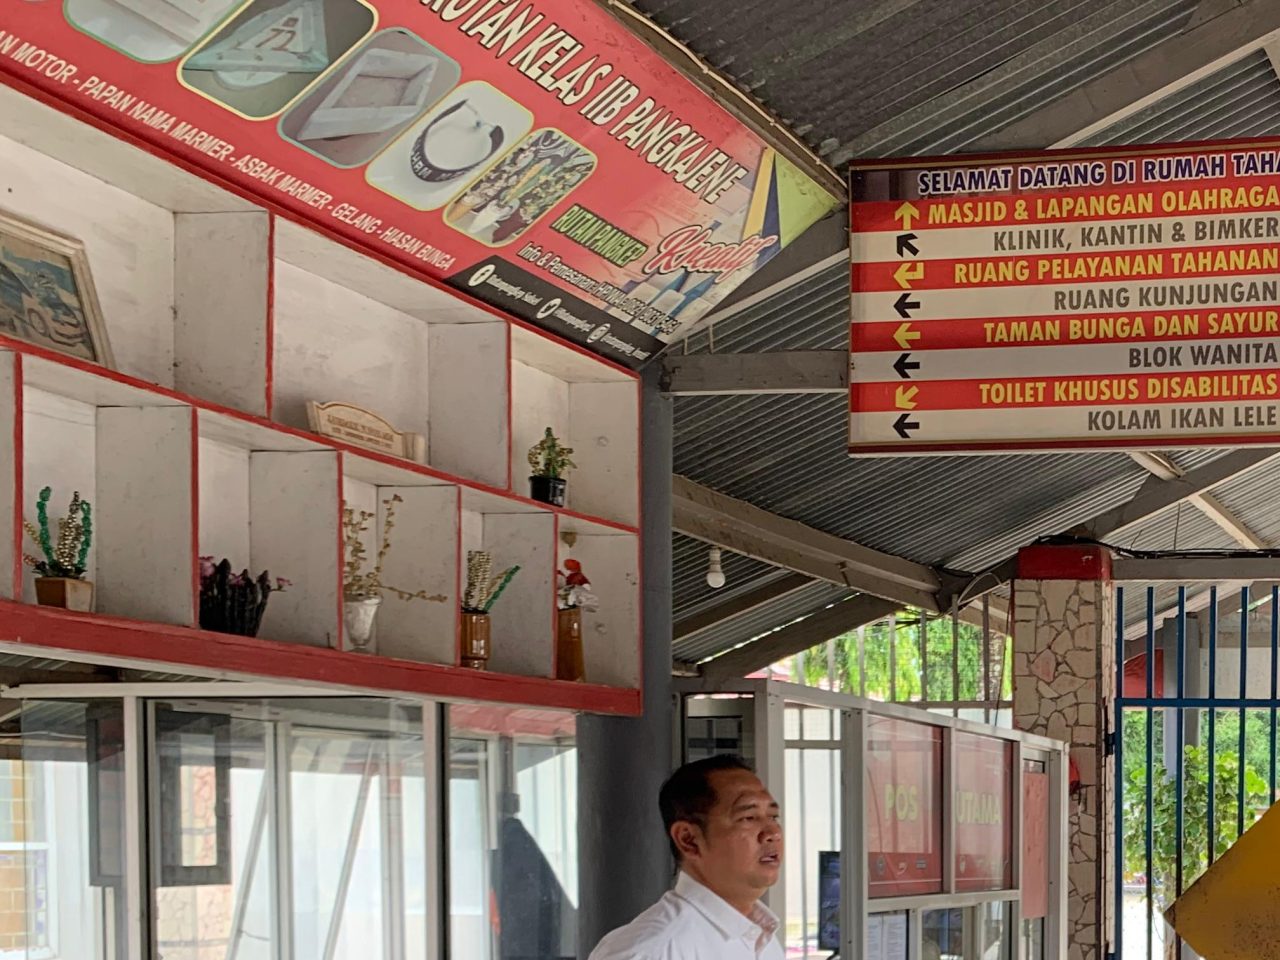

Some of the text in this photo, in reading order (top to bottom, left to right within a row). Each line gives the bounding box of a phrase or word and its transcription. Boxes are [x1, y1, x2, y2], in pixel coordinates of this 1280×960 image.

[419, 0, 748, 205] UTAN KELAS IIB PANGKAJENE
[10, 42, 77, 83] MOTOR
[78, 76, 136, 112] PAPAN
[128, 101, 176, 133] NAMA
[169, 121, 235, 162] MARMER
[232, 154, 284, 186] ASBAK
[275, 175, 333, 210] MARMER
[332, 202, 382, 234] GELANG
[379, 226, 424, 254] HIASAN
[416, 244, 457, 271] BUNGA
[918, 167, 1013, 195] SELAMAT
[1019, 162, 1106, 190] DATANG
[1111, 159, 1136, 184] DI
[1141, 153, 1226, 182] RUMAH
[928, 185, 1280, 225] MASJID & LAPANGAN OLAHRAGA
[549, 203, 650, 268] RUTAN PANGKEP
[993, 216, 1279, 252] KLINIK, KANTIN & BIMKER
[518, 242, 542, 262] Info
[537, 252, 552, 267] &
[954, 247, 1279, 284] RUANG PELAYANAN TAHANAN
[1053, 280, 1278, 311] RUANG KUNJUNGAN
[984, 310, 1279, 344] TAMAN BUNGA DAN SAYUR
[1128, 342, 1278, 368] BLOK WANITA
[979, 373, 1278, 404] TOILET KHUSUS DISABILITAS
[1088, 405, 1277, 431] KOLAM IKAN LELE
[884, 783, 1001, 825] POS UTAMA
